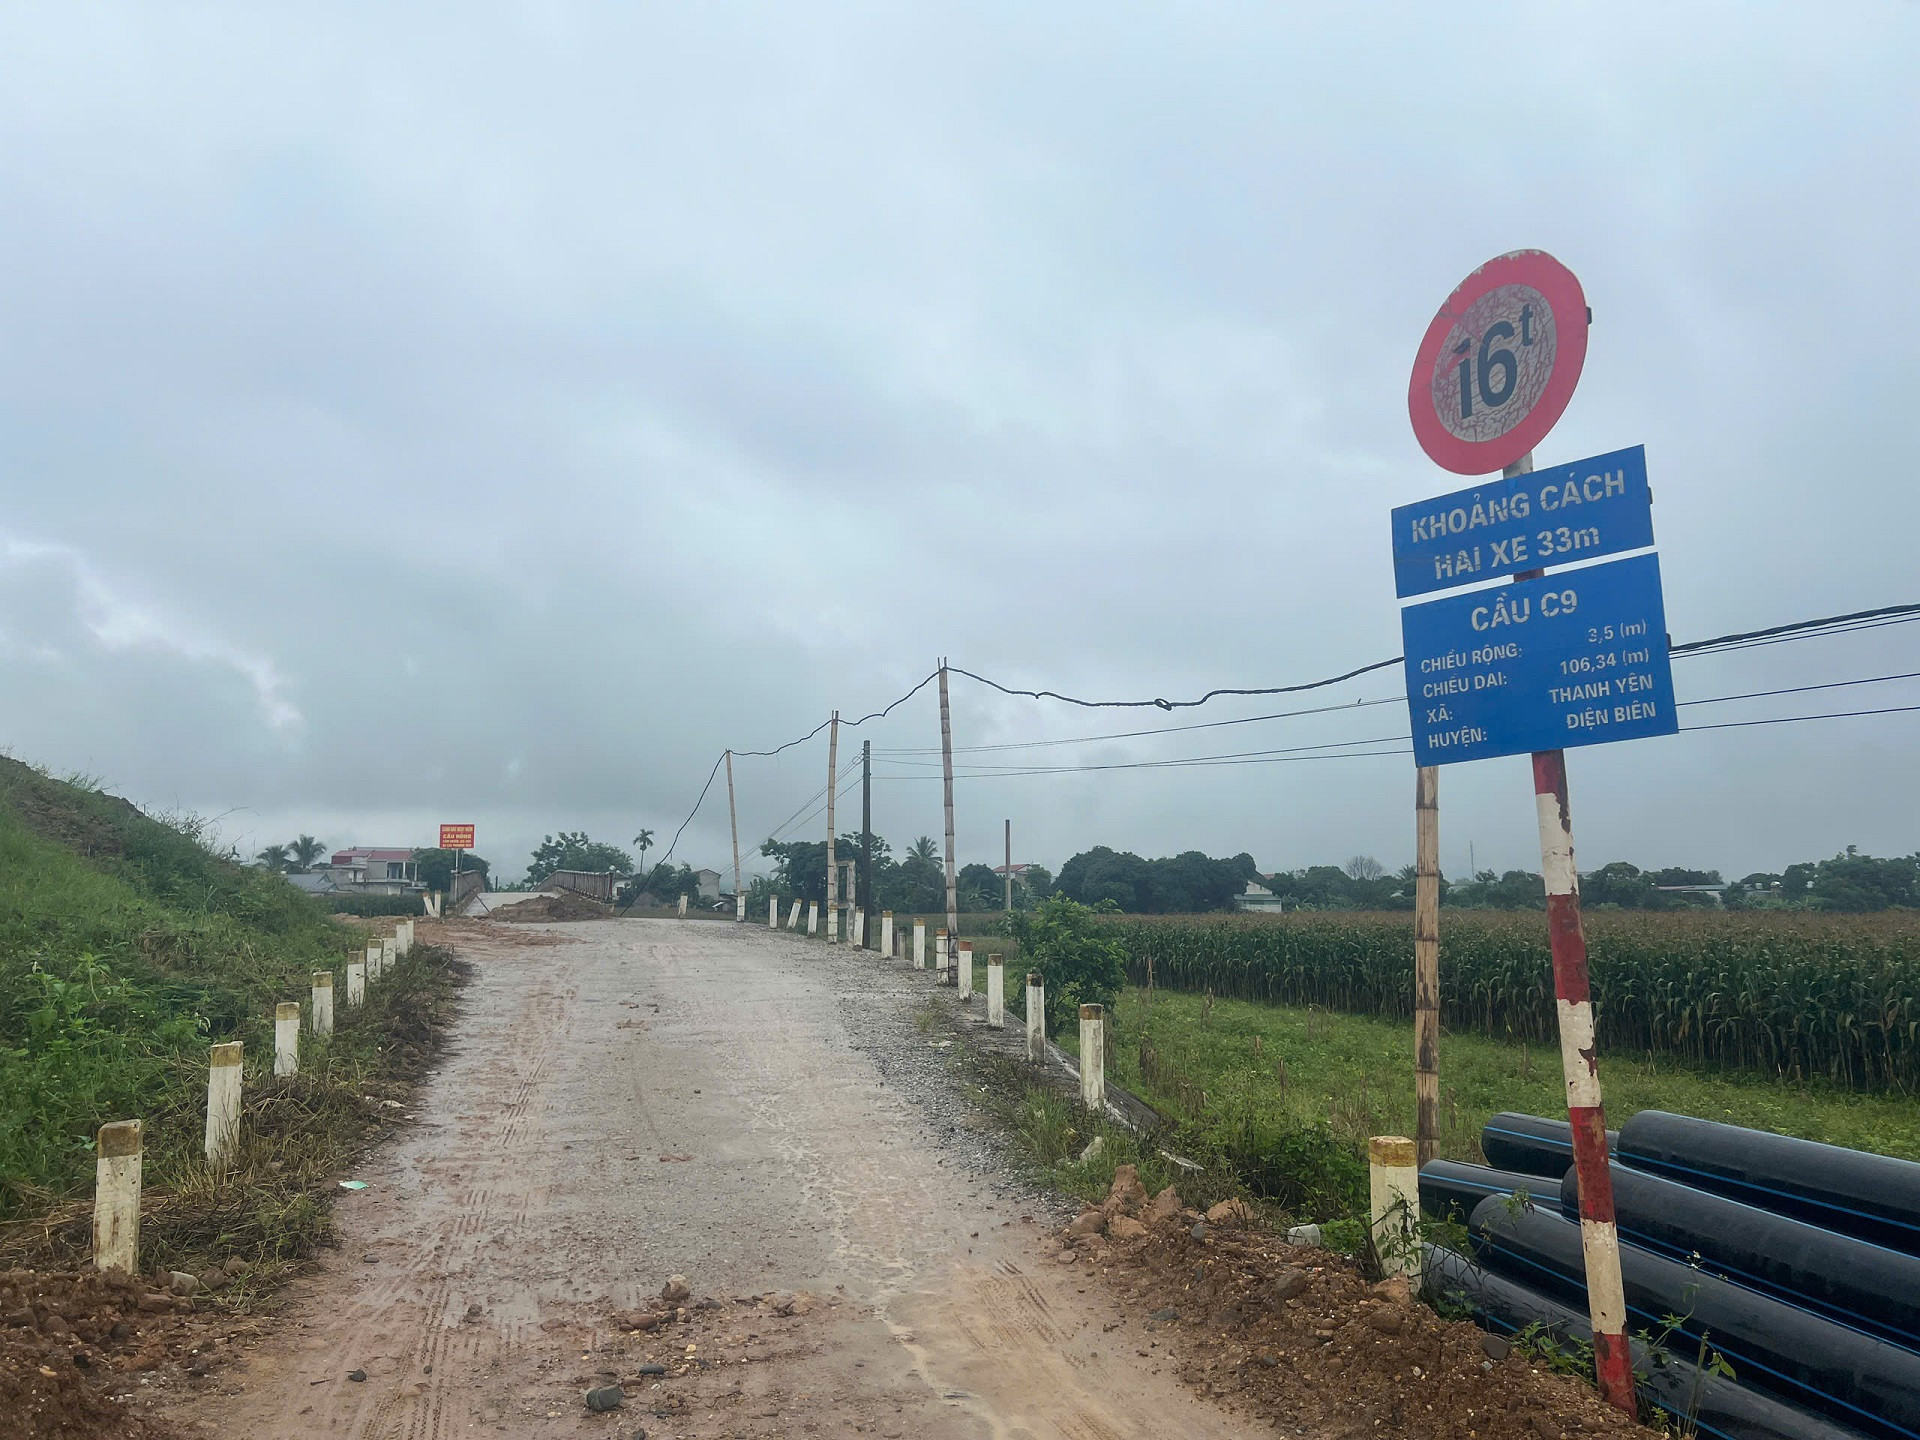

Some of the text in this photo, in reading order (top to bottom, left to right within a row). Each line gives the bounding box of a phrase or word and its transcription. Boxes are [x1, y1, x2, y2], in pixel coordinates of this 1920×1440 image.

[1411, 469, 1625, 543] KHOẢNG CÁCH
[1434, 527, 1600, 580] HAI XE 33m
[1471, 589, 1578, 632] CẦU C9
[1588, 619, 1647, 644] 3,5 (m)
[1472, 642, 1522, 666] RỘNG:
[1560, 647, 1649, 675] 106,34 (m)
[1549, 672, 1653, 704] THANH YÊN
[1427, 703, 1453, 724] XÃ:
[1566, 700, 1657, 731] ĐIỆN BIÊN
[1428, 725, 1487, 749] HUYỆN:
